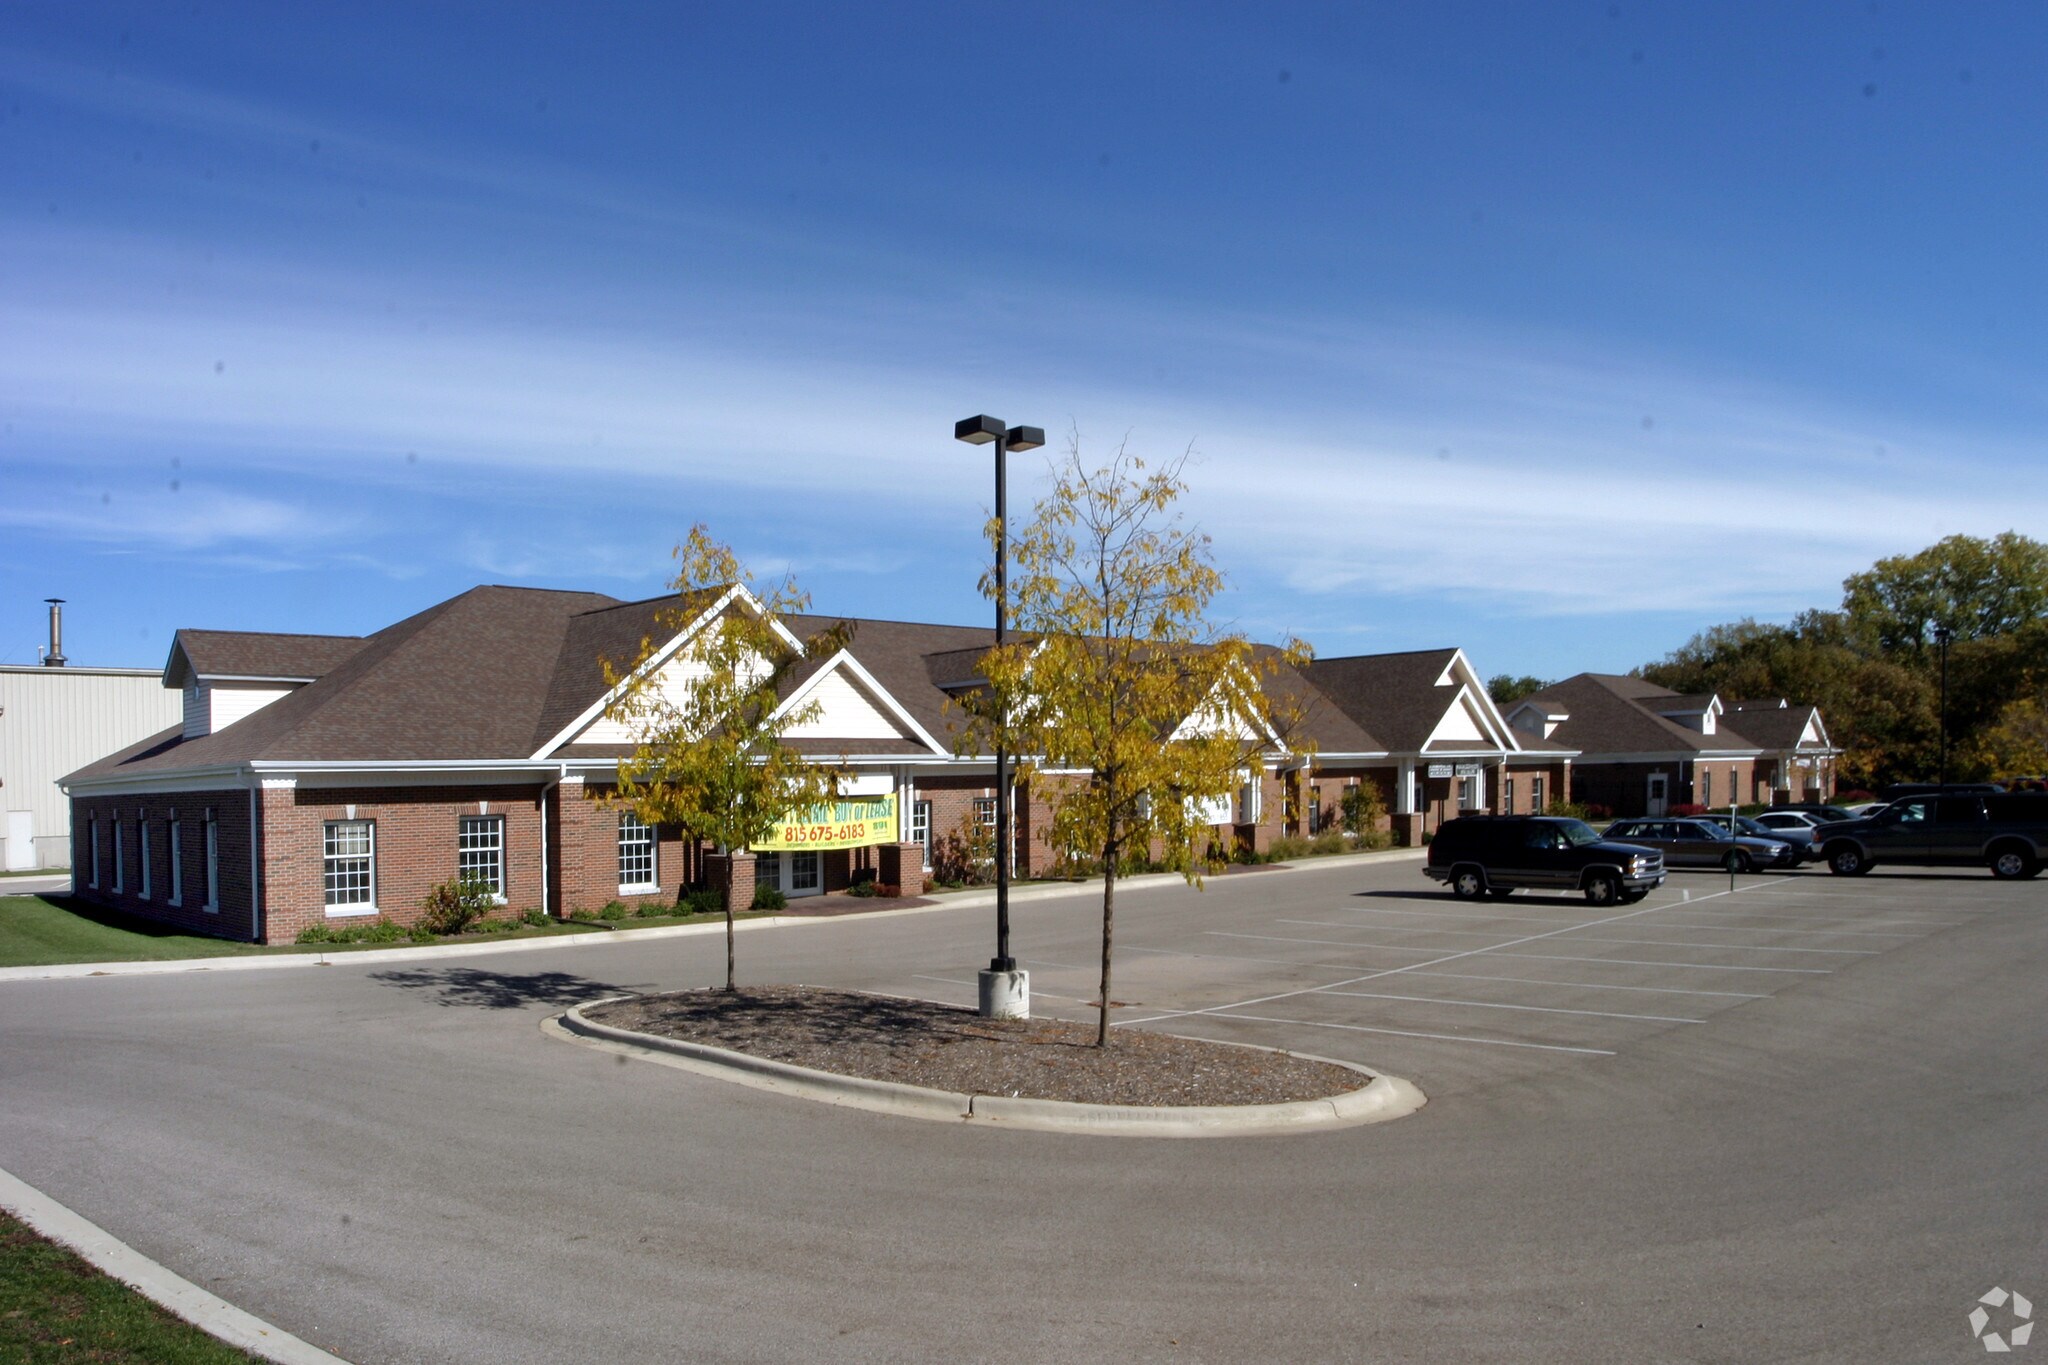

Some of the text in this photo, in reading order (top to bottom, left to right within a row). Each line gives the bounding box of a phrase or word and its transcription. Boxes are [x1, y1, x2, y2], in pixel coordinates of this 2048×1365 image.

[834, 801, 852, 822] BUY
[866, 798, 892, 819] LEASE
[785, 826, 807, 842] 815
[809, 823, 865, 842] 675-6183
